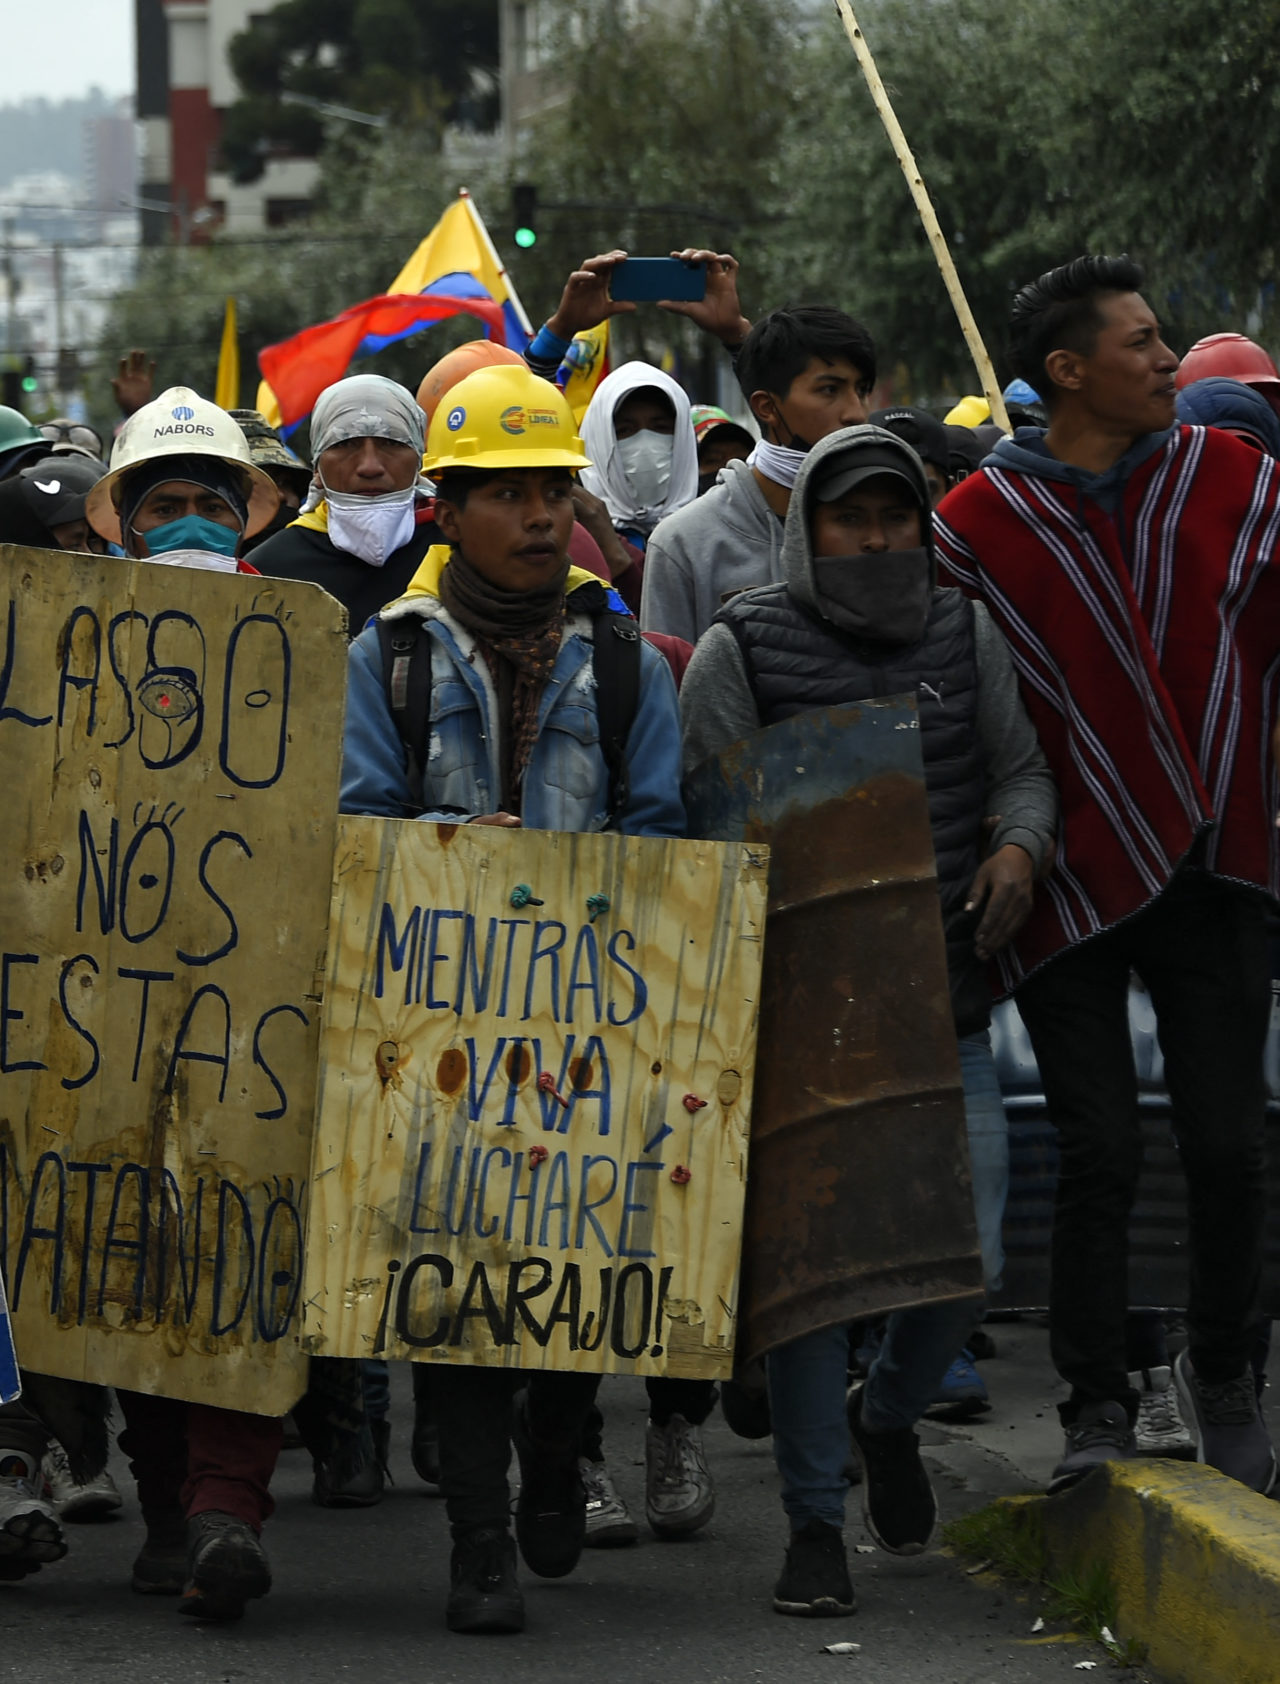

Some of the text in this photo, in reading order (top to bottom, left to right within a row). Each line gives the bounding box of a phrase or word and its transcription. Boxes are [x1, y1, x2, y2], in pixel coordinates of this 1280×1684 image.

[154, 424, 215, 438] NABORS
[76, 807, 253, 966] NOS
[375, 902, 648, 1027] MIENTRAS
[1, 953, 309, 1120] ESTAS
[464, 1035, 611, 1136] VIVA
[409, 1123, 673, 1258] LUCHARÉ
[373, 1253, 674, 1359] ¡CARAJO!
